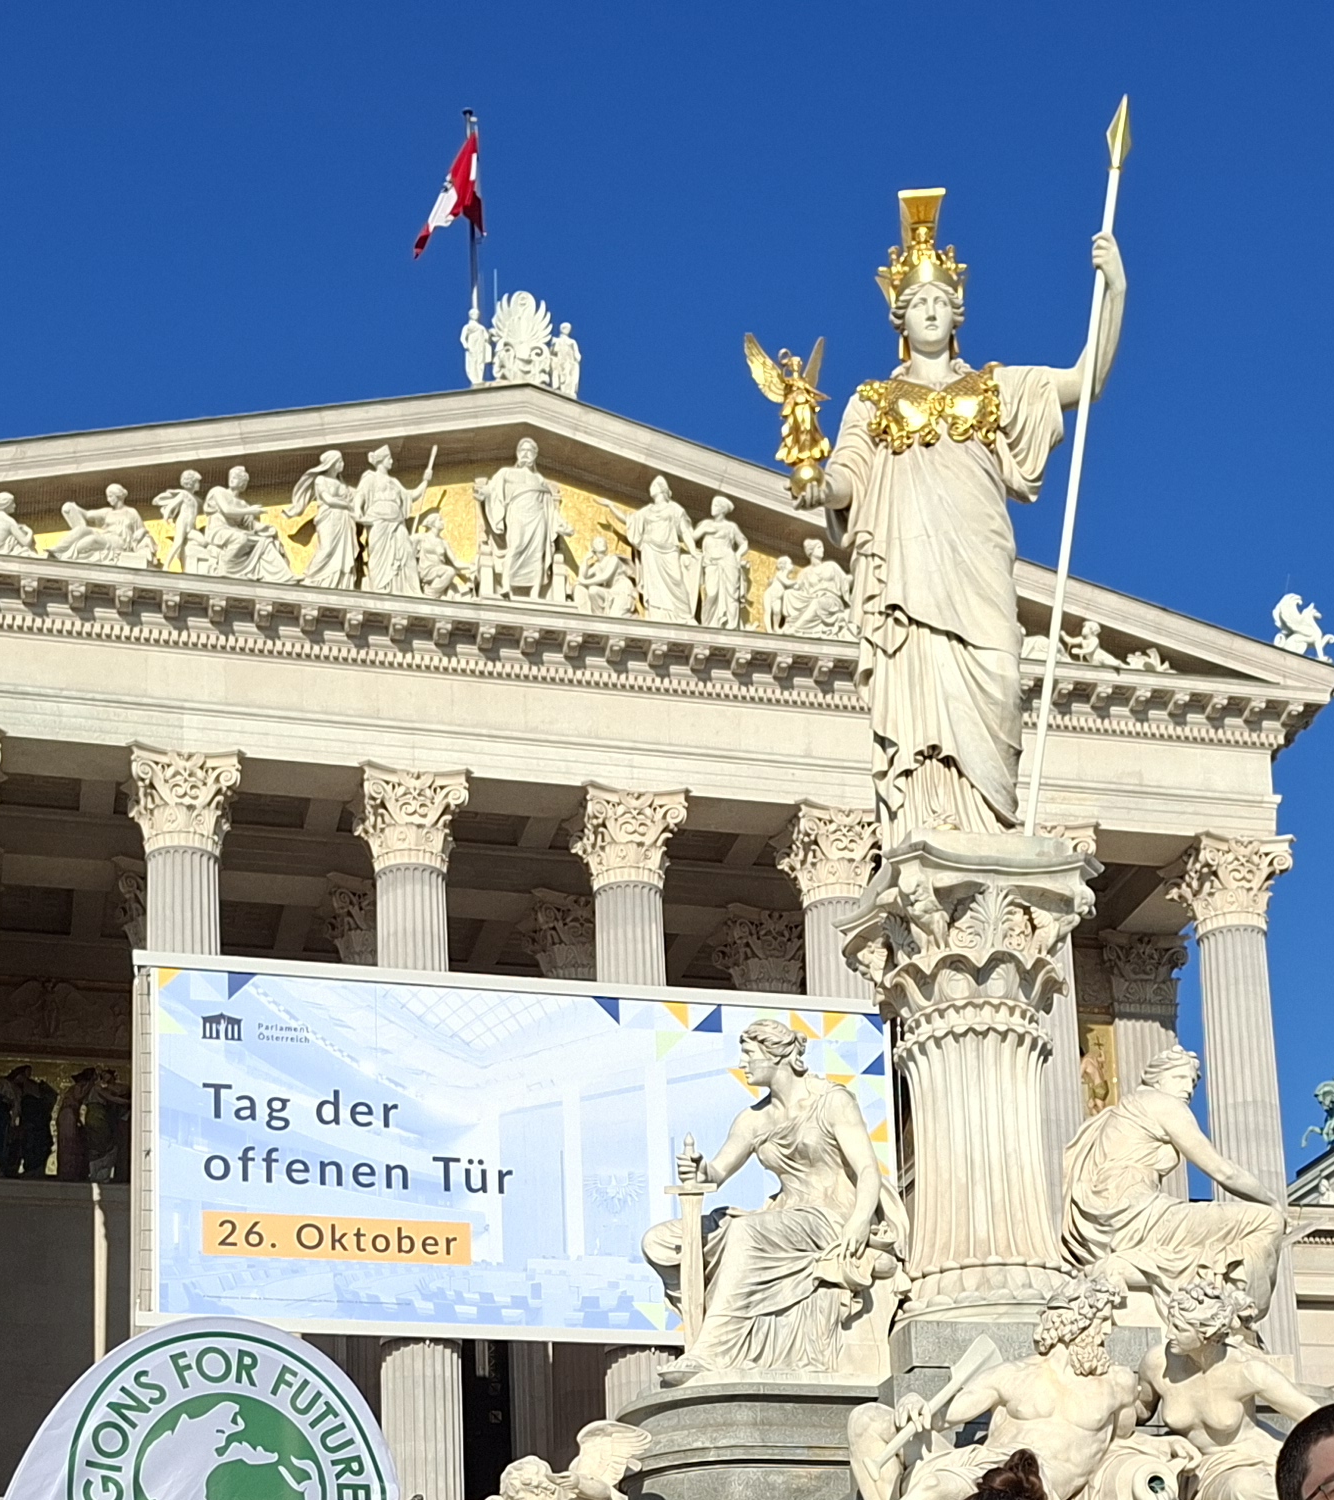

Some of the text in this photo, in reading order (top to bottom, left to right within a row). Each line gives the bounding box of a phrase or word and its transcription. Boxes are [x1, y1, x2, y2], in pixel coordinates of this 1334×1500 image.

[257, 1022, 310, 1033] Parlament
[257, 1032, 310, 1044] Österreich
[202, 1082, 399, 1131] Tag der
[203, 1145, 514, 1195] offenen Tür
[217, 1219, 458, 1256] 26. Oktober
[169, 1346, 259, 1389] FOR
